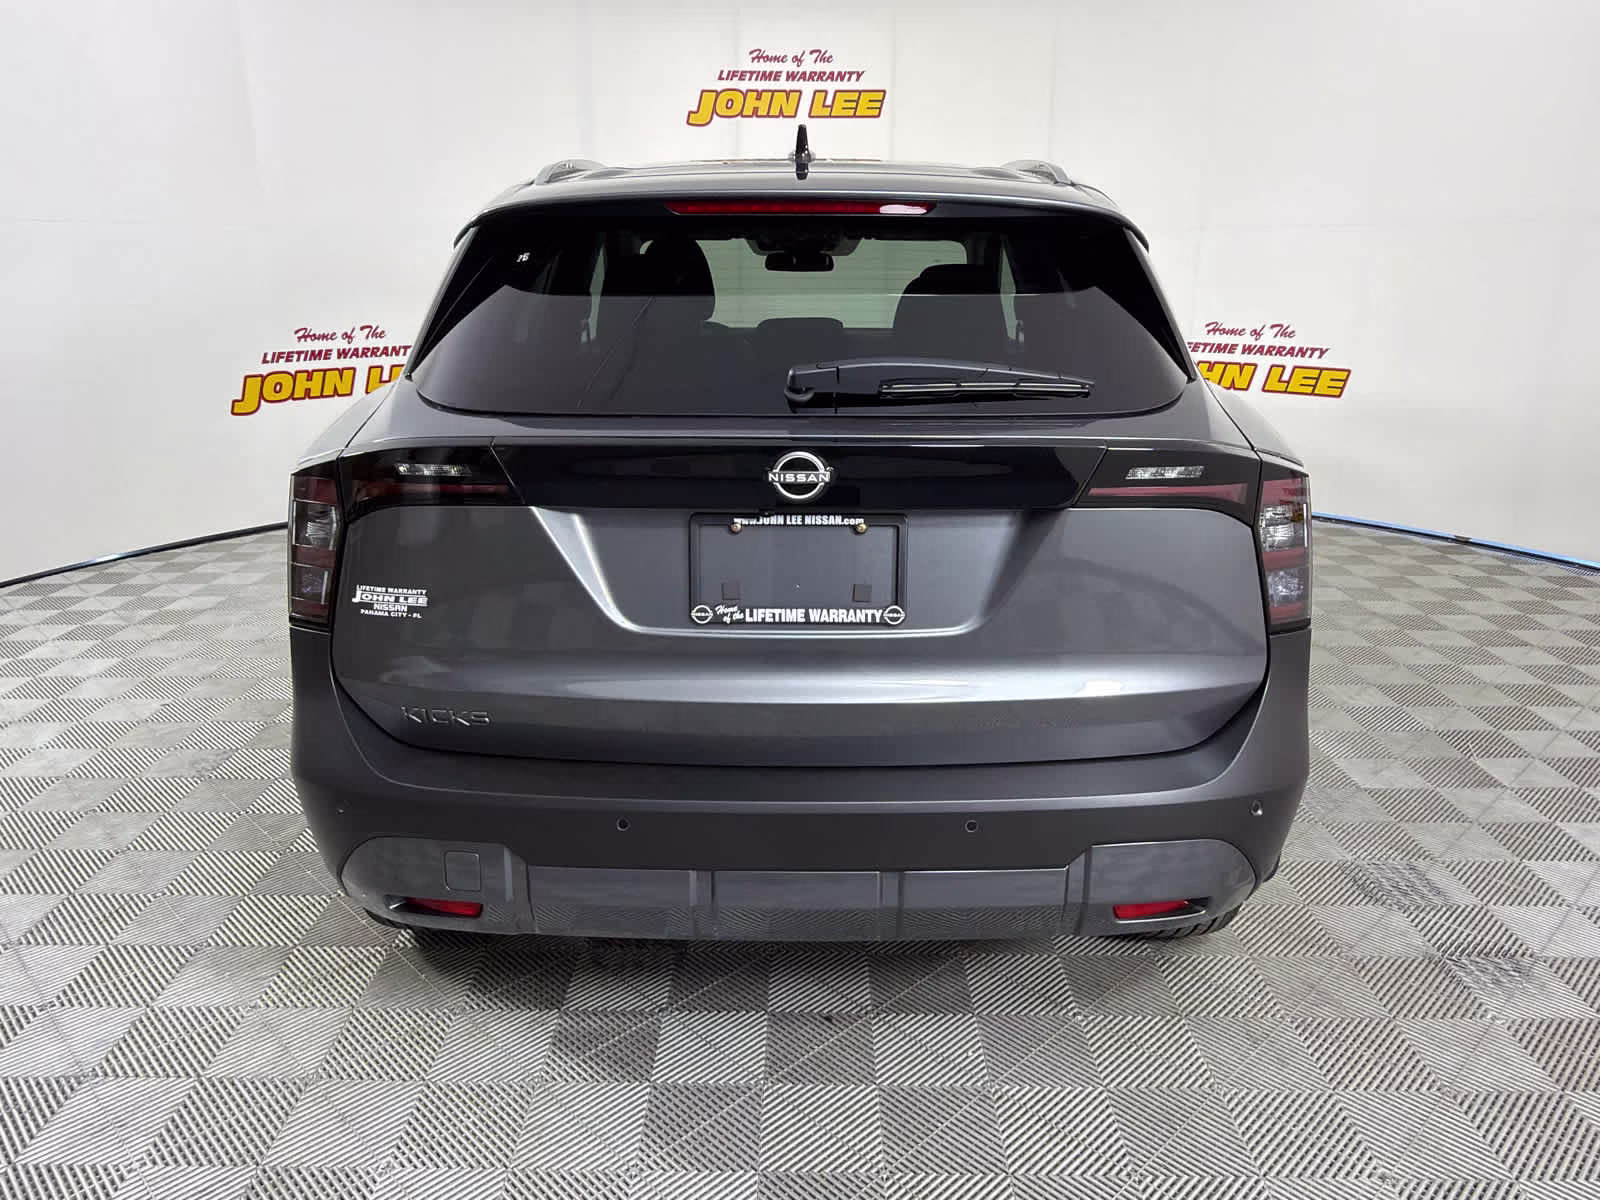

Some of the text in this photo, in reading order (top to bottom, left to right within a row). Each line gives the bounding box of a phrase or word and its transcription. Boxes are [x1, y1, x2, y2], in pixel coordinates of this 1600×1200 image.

[749, 48, 834, 68] Home of The
[717, 70, 866, 82] LIFETIME WARRANTY
[686, 88, 887, 127] JOHN LEE
[294, 325, 386, 344] Home of The
[1204, 321, 1297, 341] Home of The
[261, 344, 413, 365] LIFETIME WARRANT
[1241, 343, 1330, 360] WARRANTY
[1197, 360, 1352, 398] HN LEE
[230, 366, 357, 417] JOHN
[768, 472, 831, 483] NISSAN
[786, 515, 803, 525] LEE
[804, 515, 865, 526] NISSAN.com
[352, 591, 428, 605] JOHN LEE
[387, 587, 427, 595] WARRANTY
[373, 603, 408, 612] NISSAN
[745, 608, 883, 623] LIFETIME WARRANTY
[401, 705, 490, 727] KICKS
